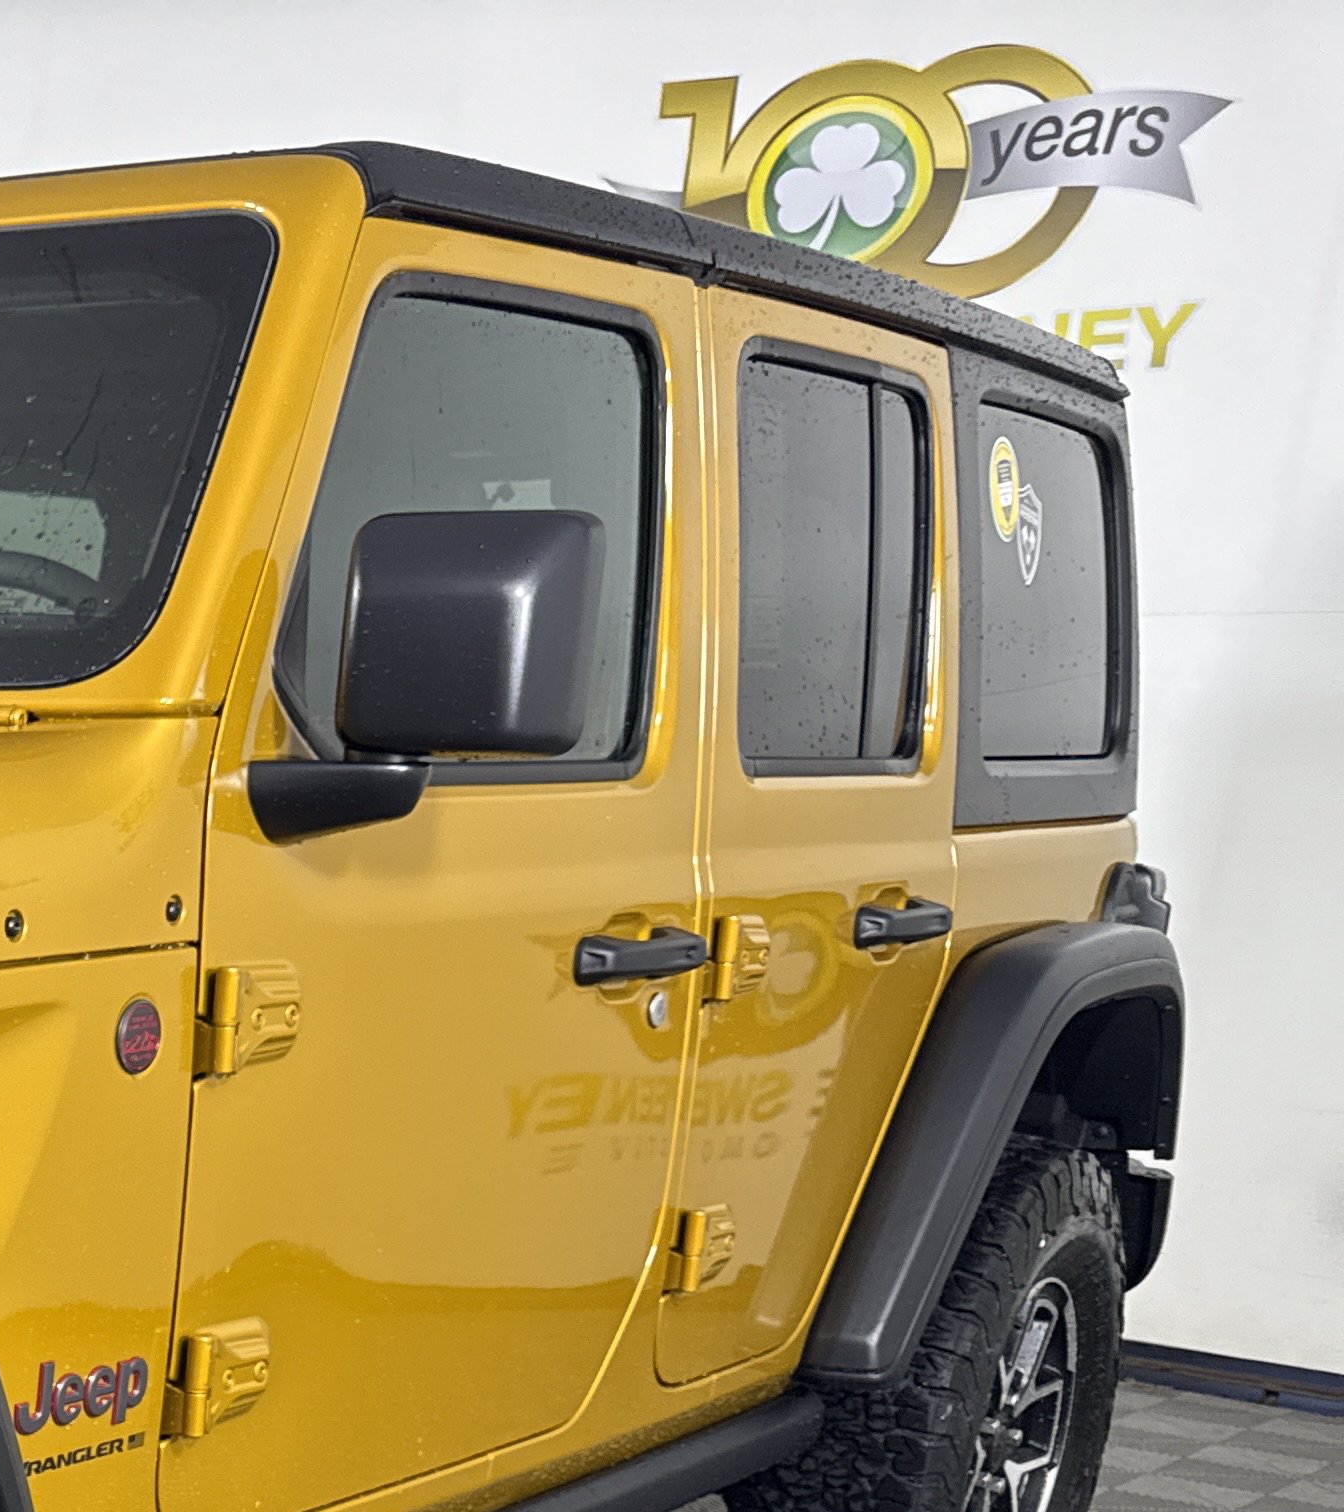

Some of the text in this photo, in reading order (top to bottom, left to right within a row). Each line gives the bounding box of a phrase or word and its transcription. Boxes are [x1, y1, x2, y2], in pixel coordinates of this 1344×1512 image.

[980, 104, 1171, 187] years
[13, 1355, 149, 1436] Jeep
[23, 1437, 124, 1478] RANGLER
